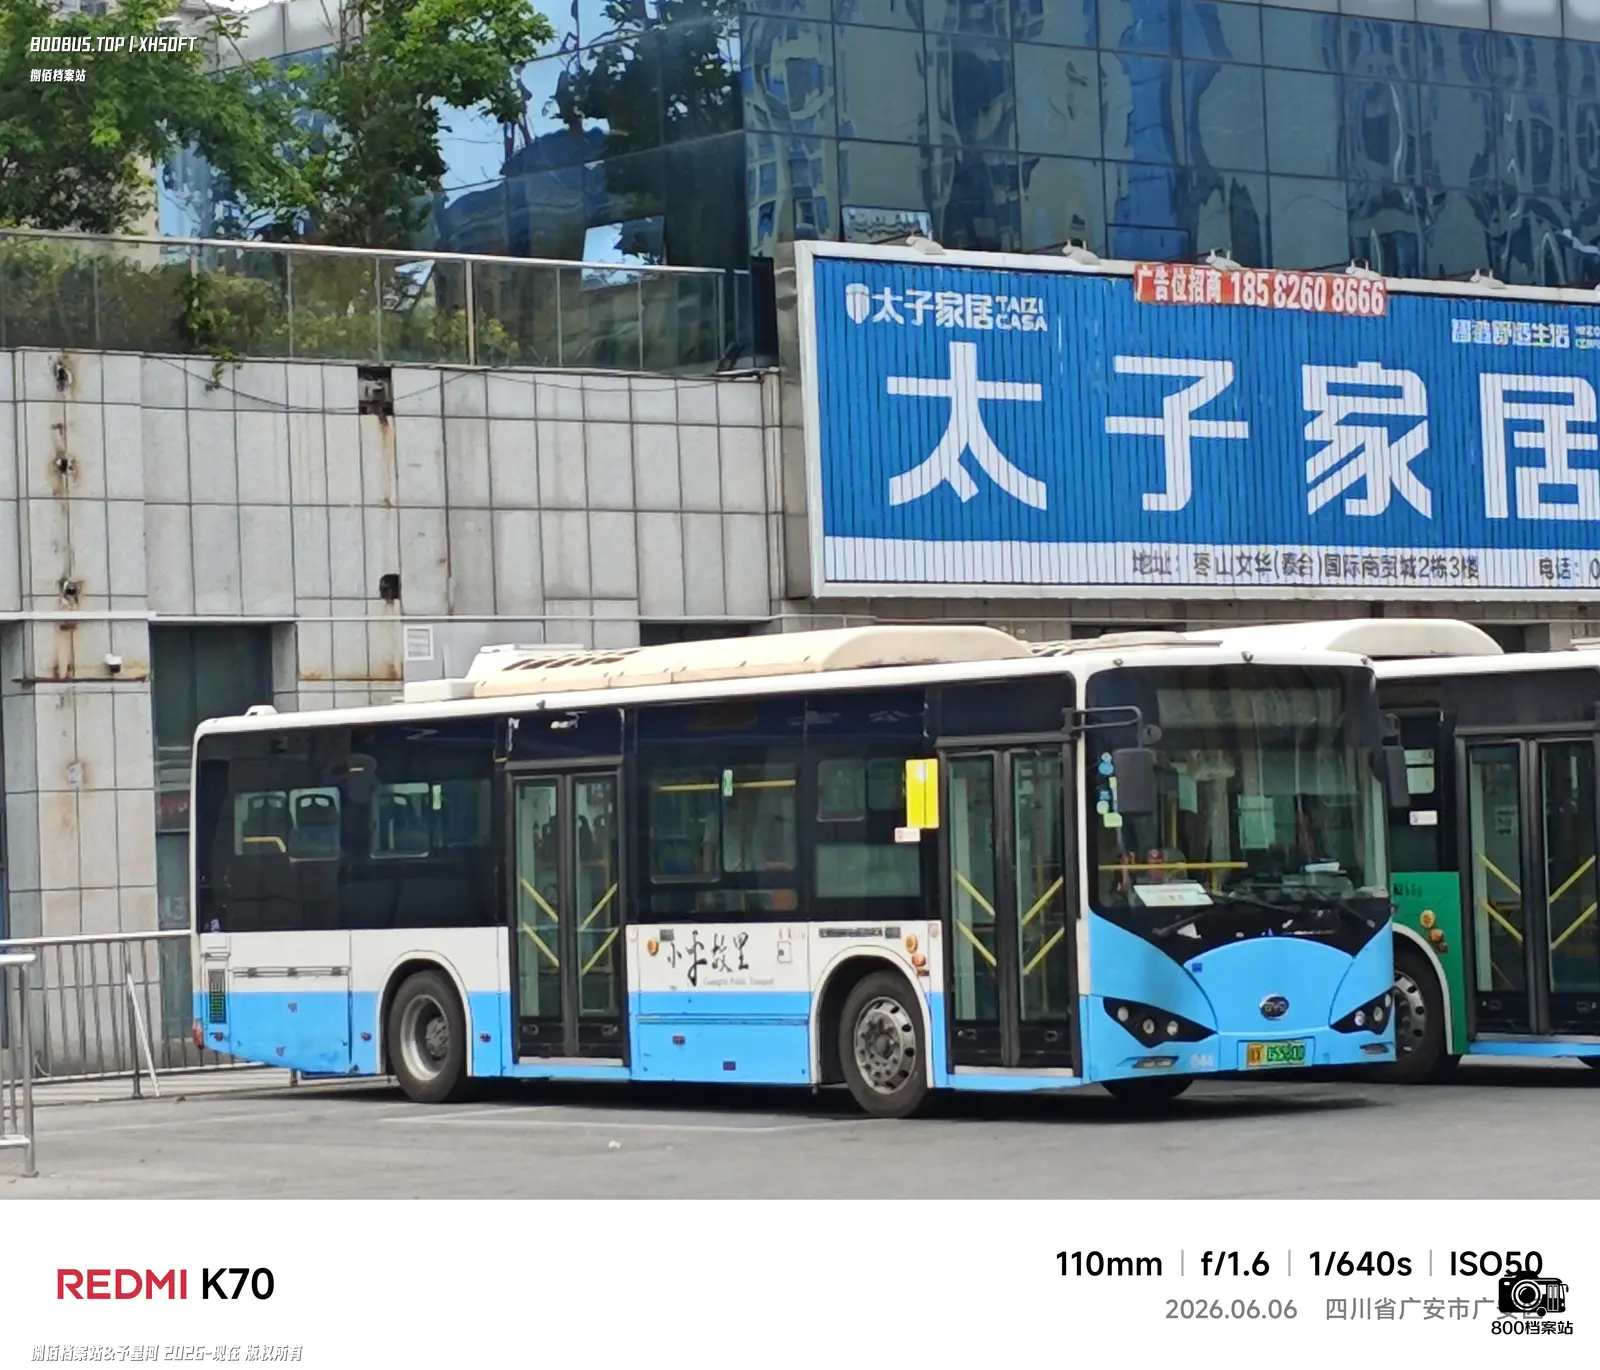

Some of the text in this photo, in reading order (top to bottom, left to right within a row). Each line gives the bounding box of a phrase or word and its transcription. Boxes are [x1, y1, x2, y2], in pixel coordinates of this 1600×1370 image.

[871, 286, 994, 330] 太子家居
[995, 295, 1044, 314] TAIZI
[1137, 265, 1223, 303] 广告位招商
[1231, 271, 1270, 306] 185
[1331, 276, 1384, 314] 8666
[996, 313, 1048, 332] CASA
[886, 341, 1600, 521] 太子家居
